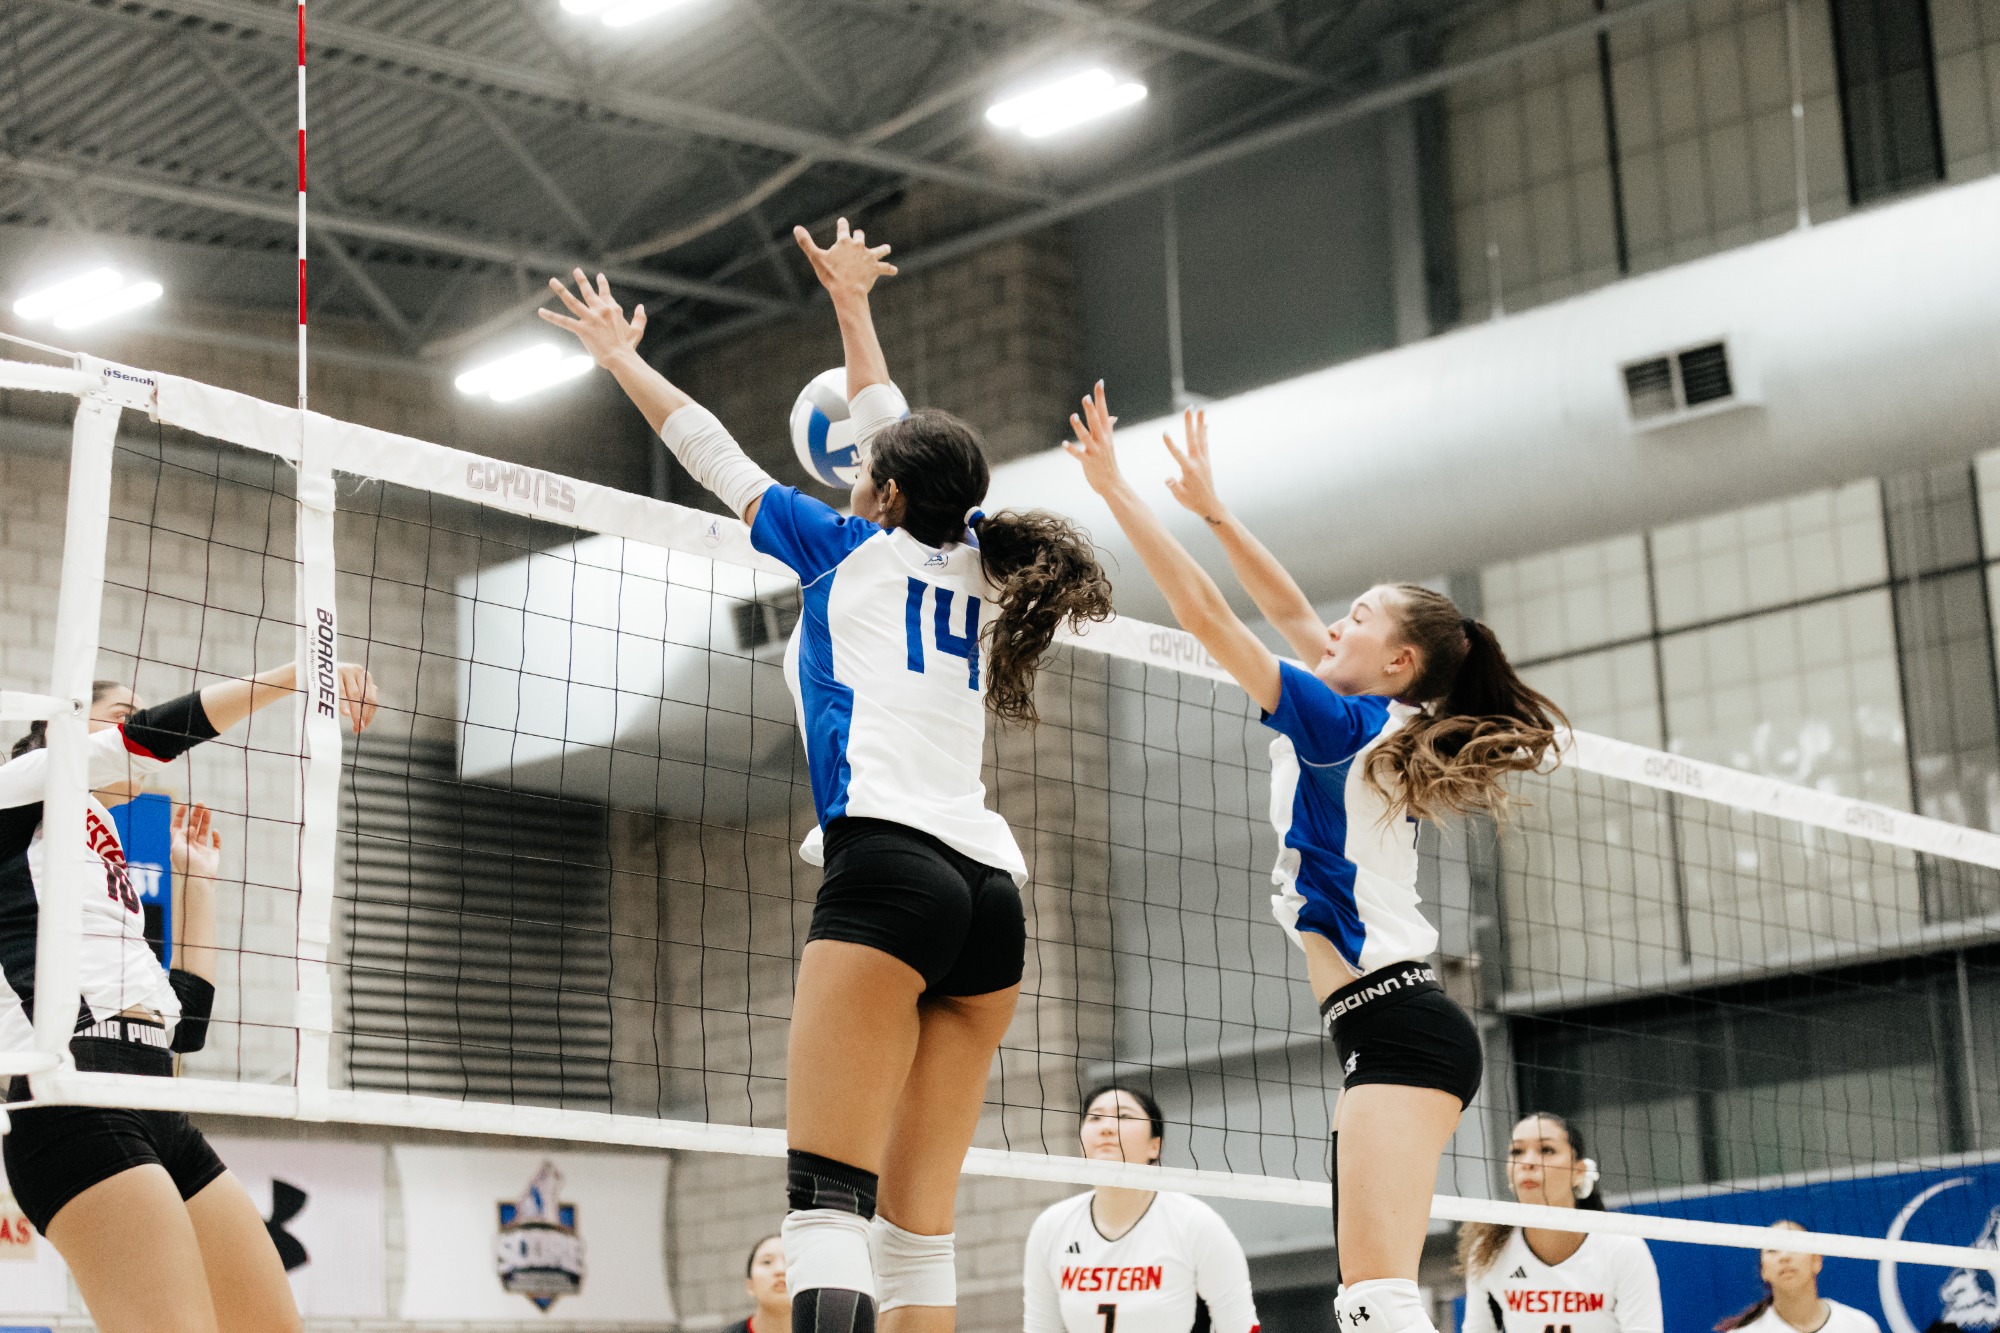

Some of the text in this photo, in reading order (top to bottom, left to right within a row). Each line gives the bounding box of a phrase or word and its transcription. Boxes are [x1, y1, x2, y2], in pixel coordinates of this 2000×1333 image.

[112, 370, 155, 386] Senoh
[466, 462, 576, 513] COYOTES
[905, 575, 981, 691] 14
[316, 607, 335, 719] BOARDEE
[127, 1022, 169, 1049] PUM
[0, 1217, 31, 1245] AS
[1061, 1265, 1162, 1291] WESTERN
[1503, 1289, 1604, 1312] WESTERN
